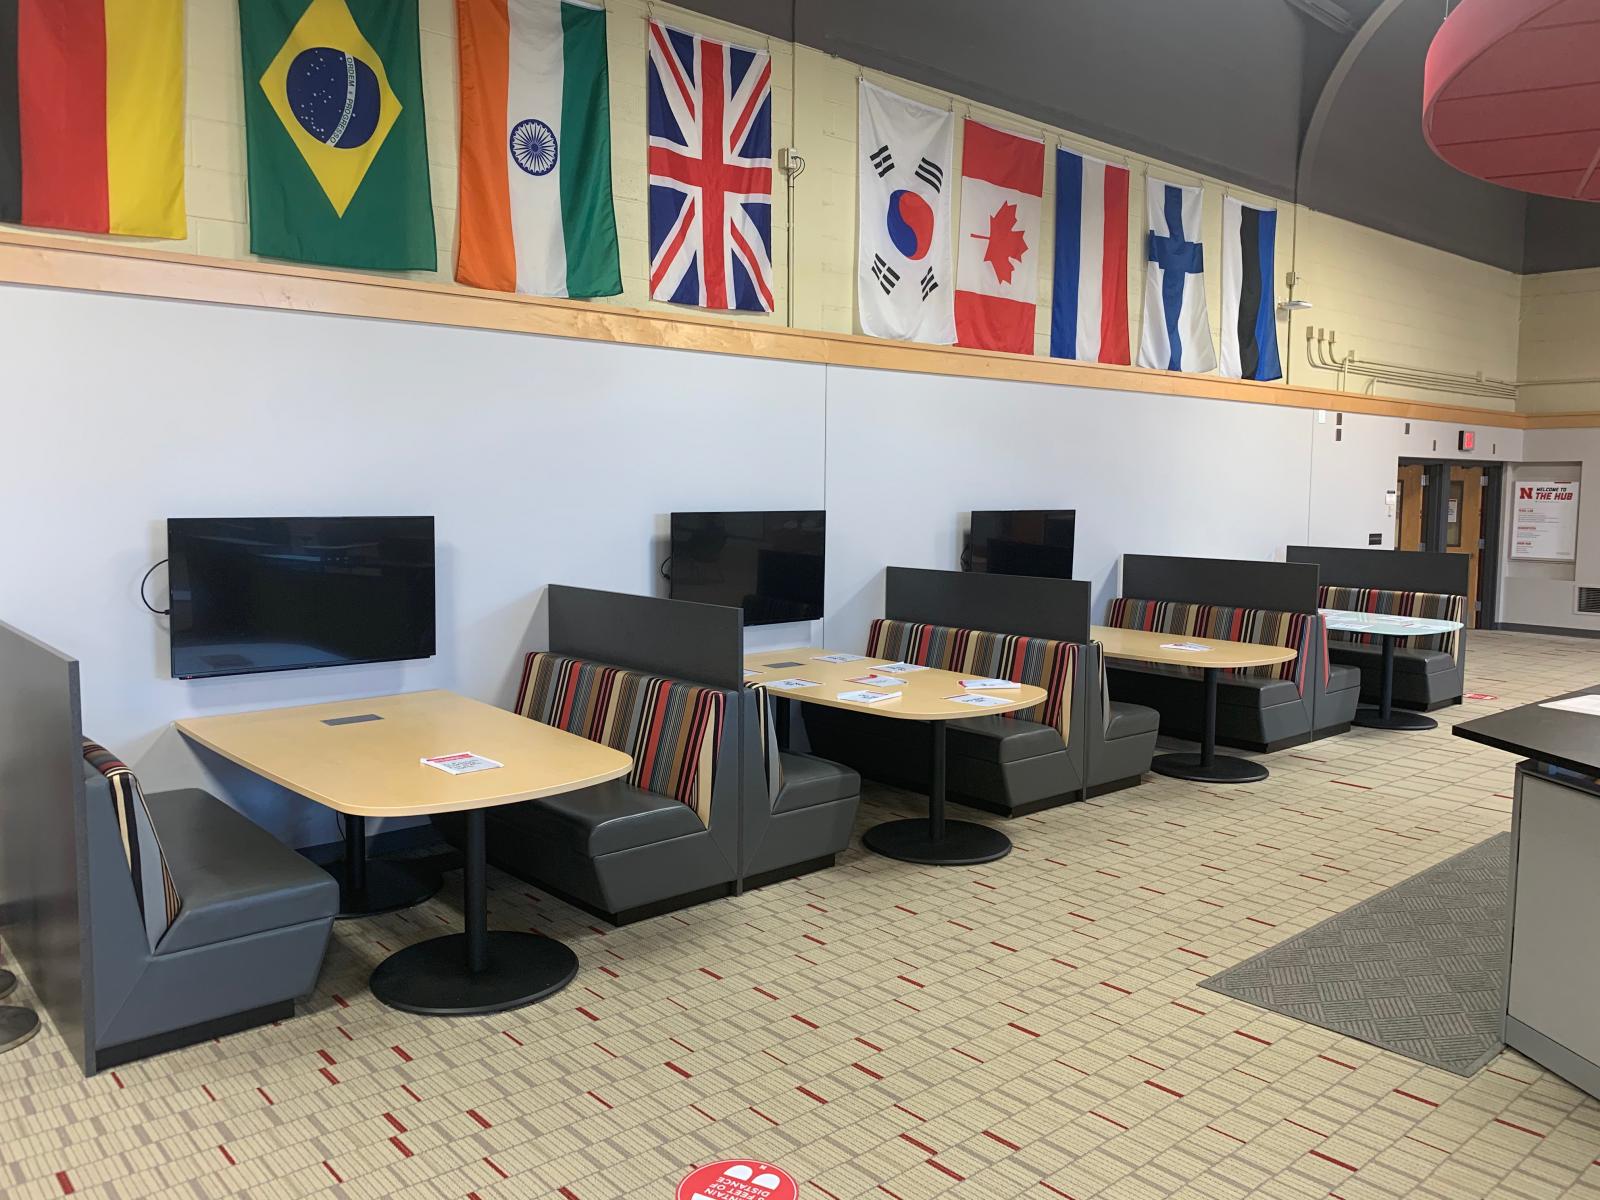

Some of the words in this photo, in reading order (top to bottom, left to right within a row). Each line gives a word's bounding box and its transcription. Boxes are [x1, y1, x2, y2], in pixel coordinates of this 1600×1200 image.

[347, 57, 355, 87] ORDEM
[329, 98, 354, 144] PROGRESSO
[1520, 488, 1533, 499] N
[709, 1183, 726, 1191] OF
[716, 1176, 771, 1197] DISTANCE
